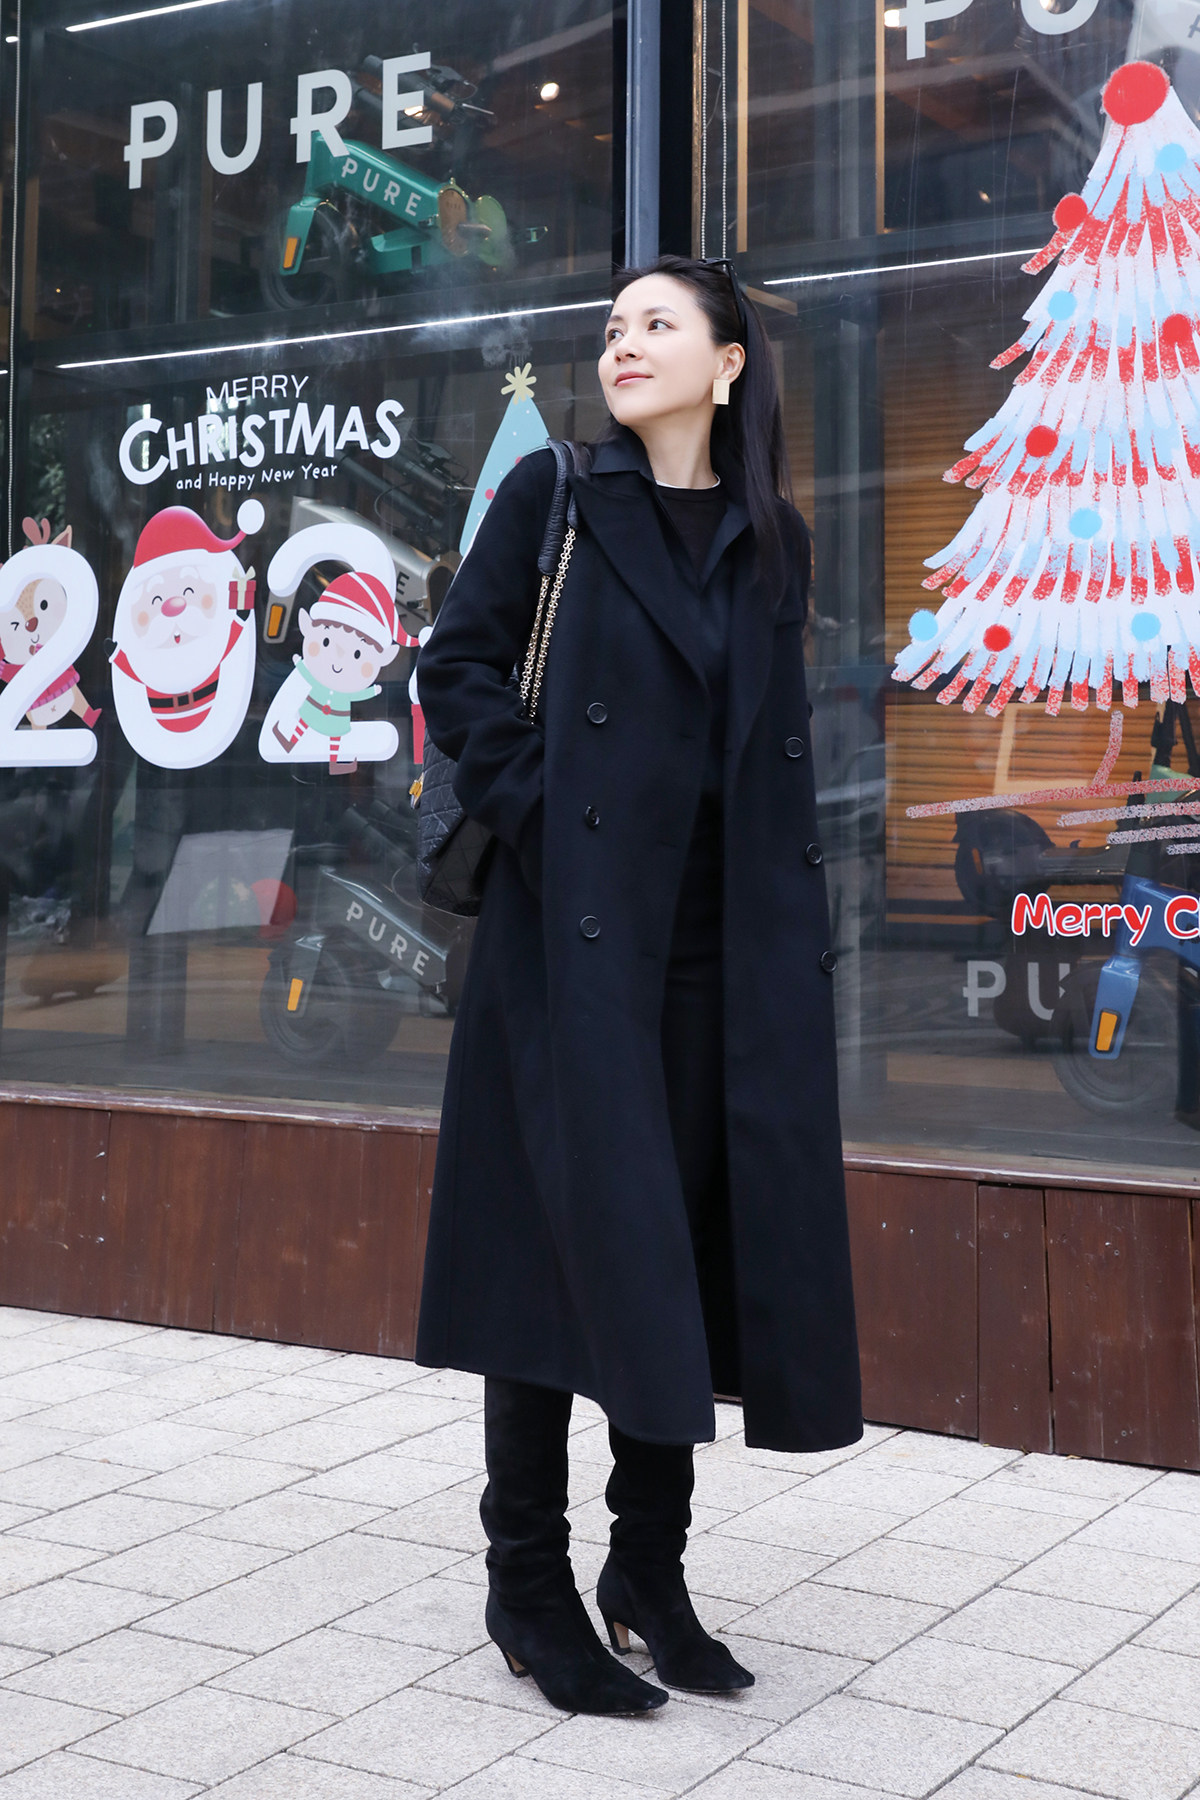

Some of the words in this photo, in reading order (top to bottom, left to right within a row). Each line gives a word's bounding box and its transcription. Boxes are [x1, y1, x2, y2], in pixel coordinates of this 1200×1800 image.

[124, 52, 432, 189] PURE
[341, 157, 422, 217] PURE
[205, 374, 309, 403] MERRY
[119, 399, 405, 485] CHRISTMAS
[176, 473, 202, 490] and
[208, 471, 256, 492] Happy
[261, 465, 294, 483] New
[301, 462, 337, 480] Year
[0, 523, 418, 770] 202
[346, 901, 430, 976] PURE
[1011, 893, 1152, 946] Merry
[1164, 895, 1200, 939] C
[963, 960, 1071, 1021] PU
